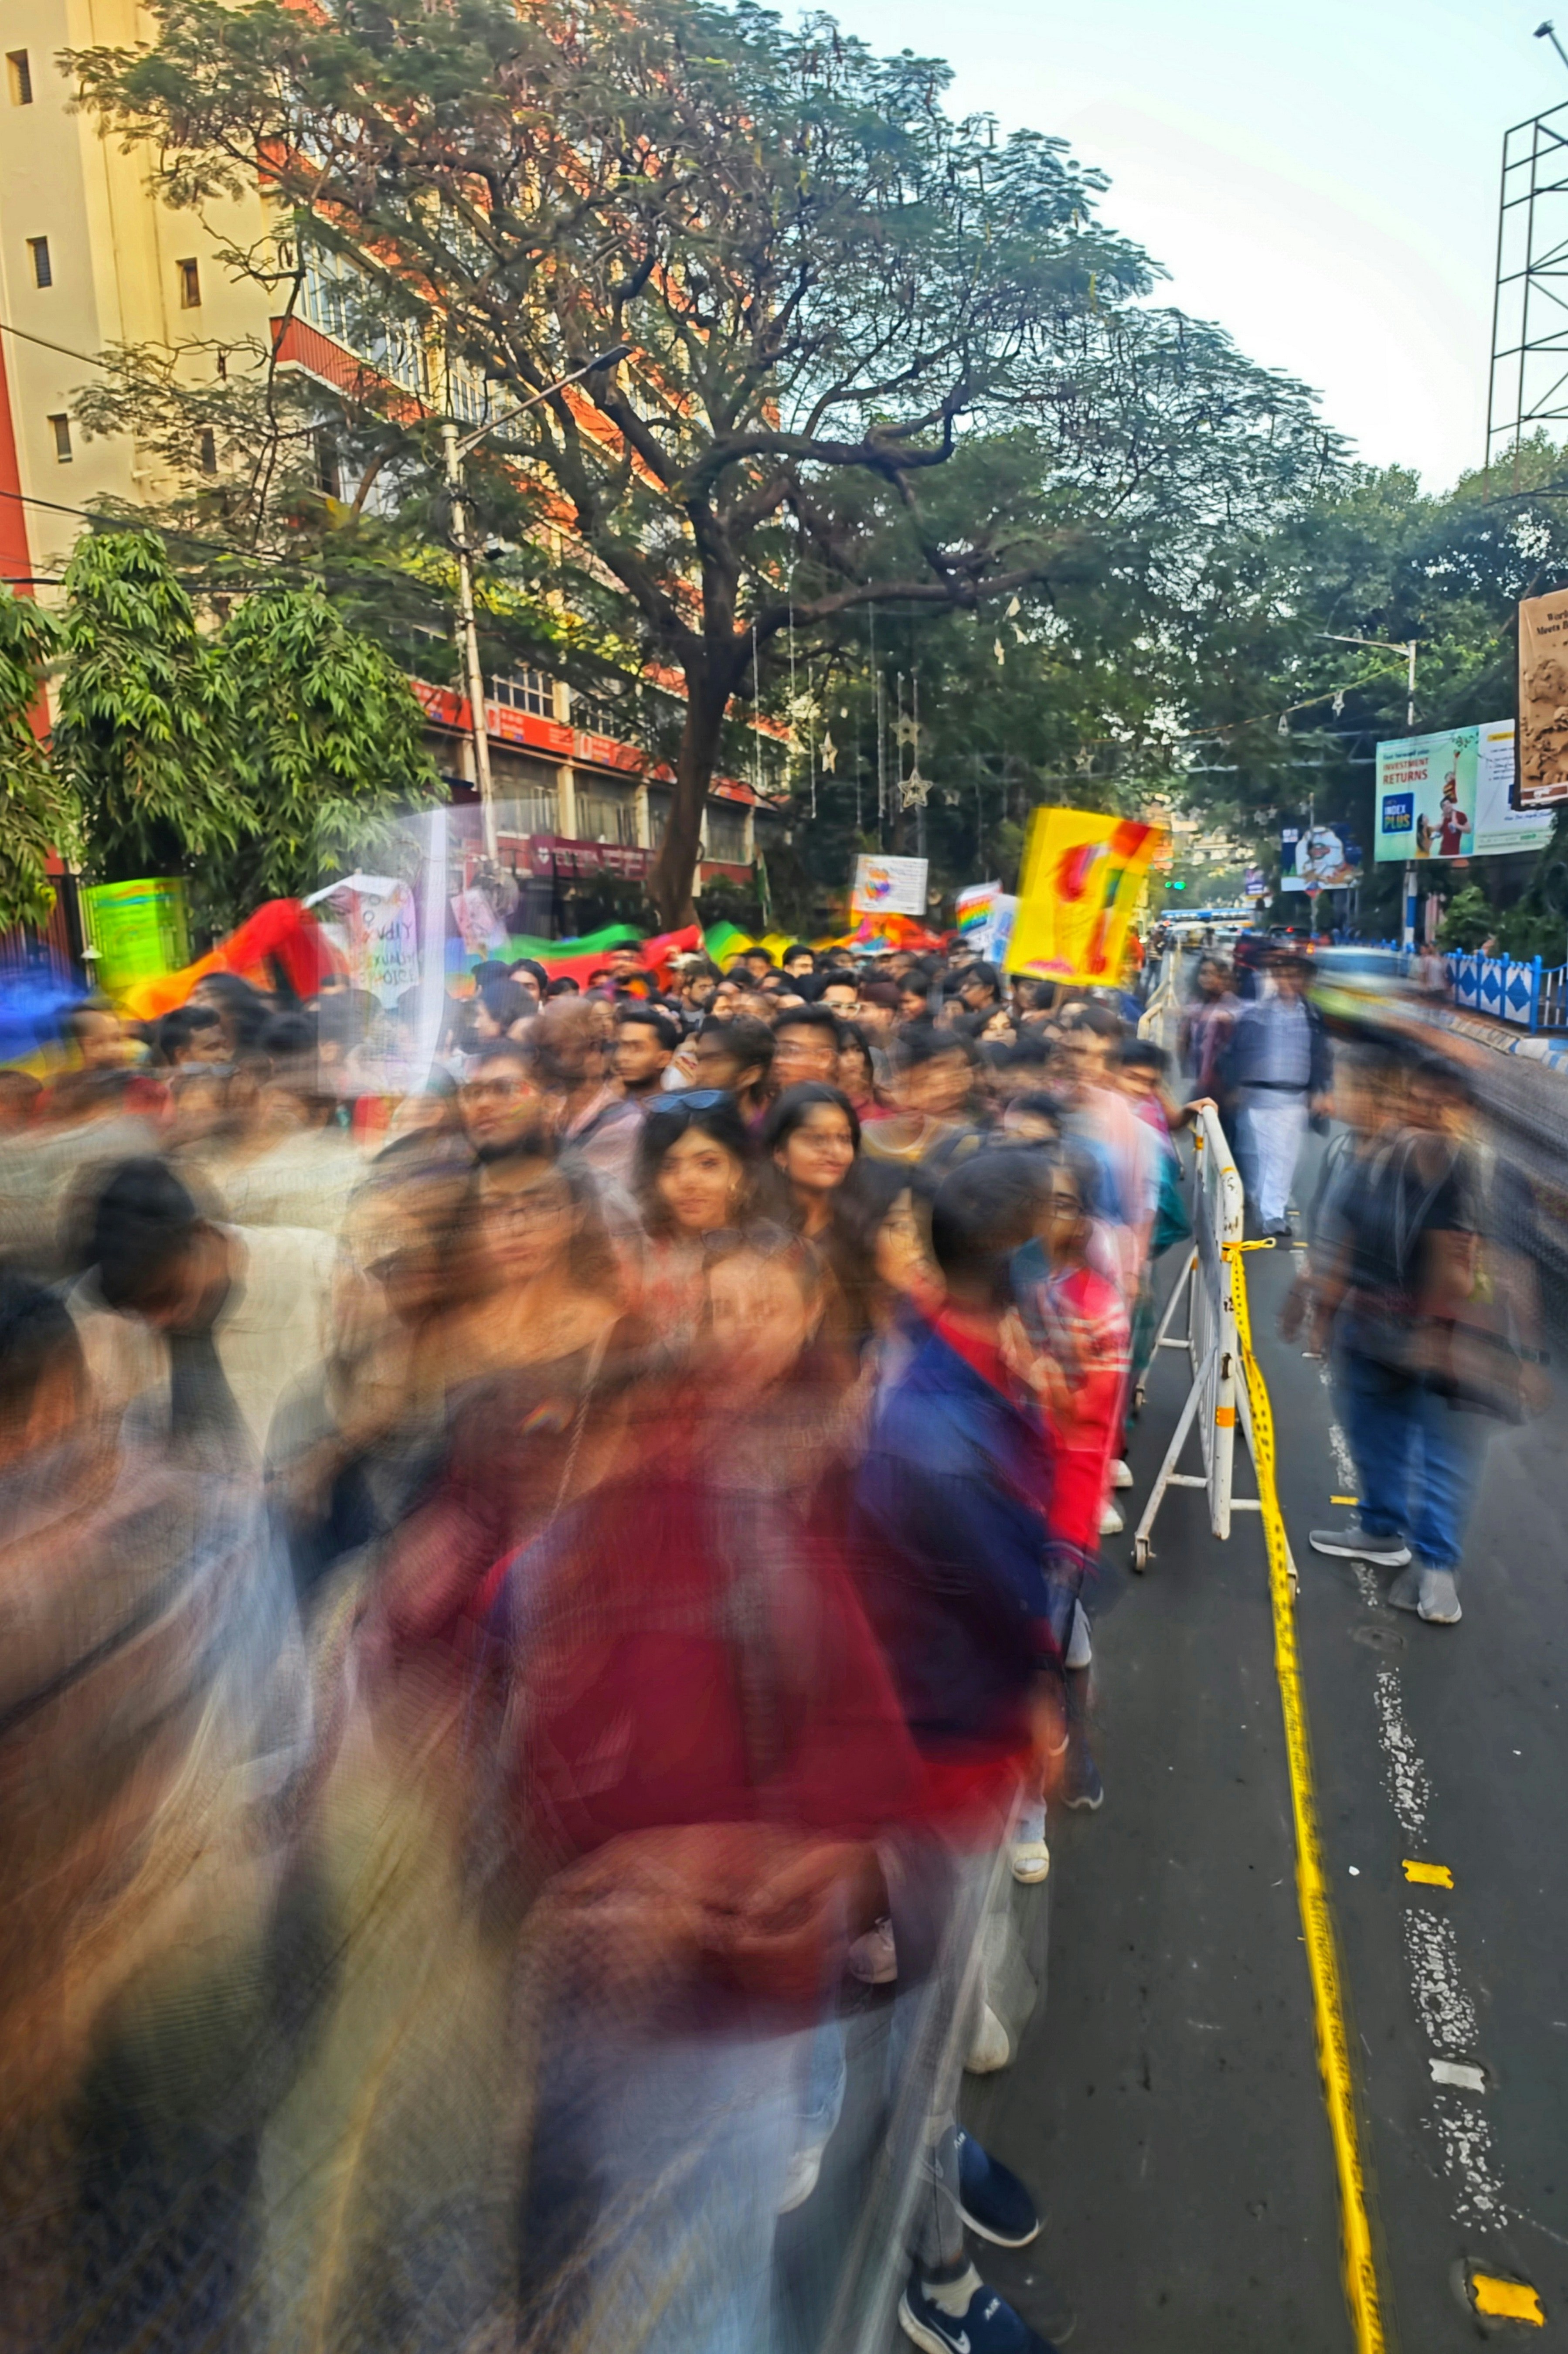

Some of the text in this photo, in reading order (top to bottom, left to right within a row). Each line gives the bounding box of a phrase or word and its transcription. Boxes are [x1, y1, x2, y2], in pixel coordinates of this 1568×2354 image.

[1536, 625, 1560, 635] Meets
[1383, 757, 1429, 771] INVESTMENT
[1383, 768, 1428, 785] RETURNS
[1385, 805, 1406, 816] INDEX
[1384, 813, 1410, 829] PLUS
[954, 2132, 966, 2149] AIR
[984, 2296, 1001, 2321] AIR
